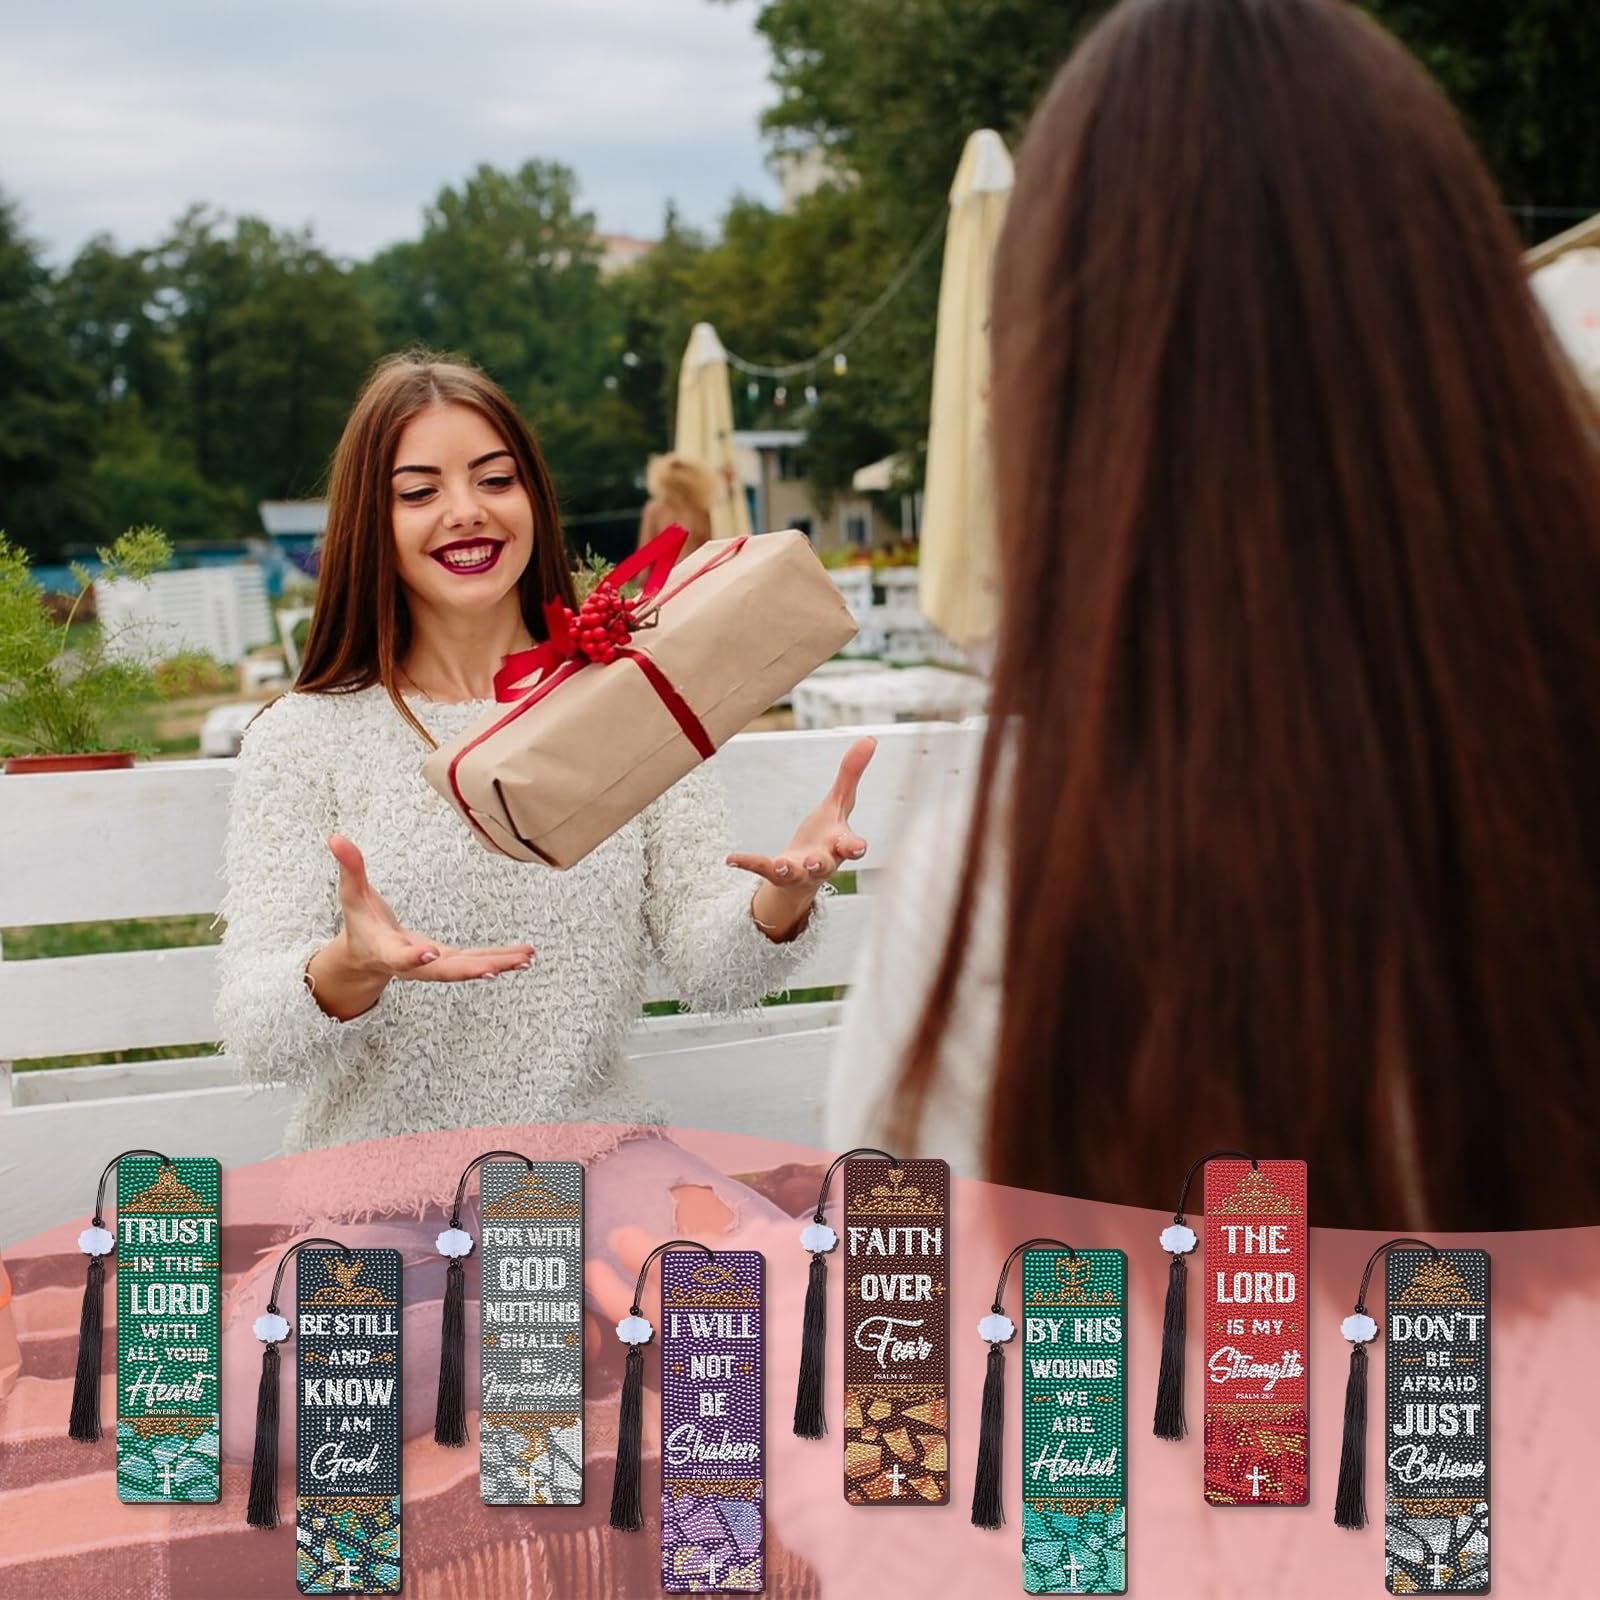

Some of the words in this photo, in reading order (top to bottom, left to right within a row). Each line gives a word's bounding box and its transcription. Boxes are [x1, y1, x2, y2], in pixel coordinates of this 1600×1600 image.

[118, 1218, 217, 1244] TRUST
[483, 1228, 524, 1247] FOR
[527, 1228, 580, 1247] WITH
[848, 1227, 942, 1256] FAITH
[1221, 1226, 1290, 1254] THE
[133, 1256, 154, 1272] IN
[161, 1257, 202, 1272] THE
[499, 1257, 566, 1290] GOD
[130, 1283, 210, 1315] LORD
[861, 1274, 933, 1301] OVER
[1216, 1272, 1295, 1304] LORD
[300, 1315, 331, 1335] BE
[334, 1313, 398, 1335] STILL
[486, 1301, 580, 1323] NOTHING
[140, 1324, 197, 1339] WITH
[670, 1314, 678, 1338] I
[688, 1313, 757, 1338] WILL
[1025, 1318, 1064, 1344] BY
[1074, 1317, 1122, 1344] HIS
[1227, 1319, 1244, 1335] IS
[1252, 1319, 1283, 1335] MY
[1392, 1312, 1485, 1341] DON'T
[500, 1333, 566, 1349] SHALL
[854, 1316, 932, 1369] Fear
[127, 1346, 158, 1362] ALL
[164, 1348, 208, 1362] YOUR
[329, 1350, 371, 1365] AND
[520, 1358, 544, 1374] BE
[1425, 1351, 1450, 1367] BE
[690, 1355, 736, 1379] NOT
[1030, 1359, 1118, 1379] WOUNDS
[1208, 1346, 1304, 1391] Strength
[125, 1365, 216, 1407] Heart
[304, 1378, 394, 1406] KNOW
[1401, 1376, 1478, 1392] AFRAID
[700, 1392, 729, 1417] BE
[1056, 1391, 1088, 1406] WE
[326, 1417, 331, 1432] I
[340, 1417, 371, 1432] AM
[1052, 1416, 1095, 1432] ARE
[1393, 1404, 1480, 1436] JUST
[666, 1423, 760, 1465] Shaken
[310, 1441, 379, 1482] God
[1030, 1439, 1117, 1482] Healed
[1388, 1444, 1486, 1483] Believe
